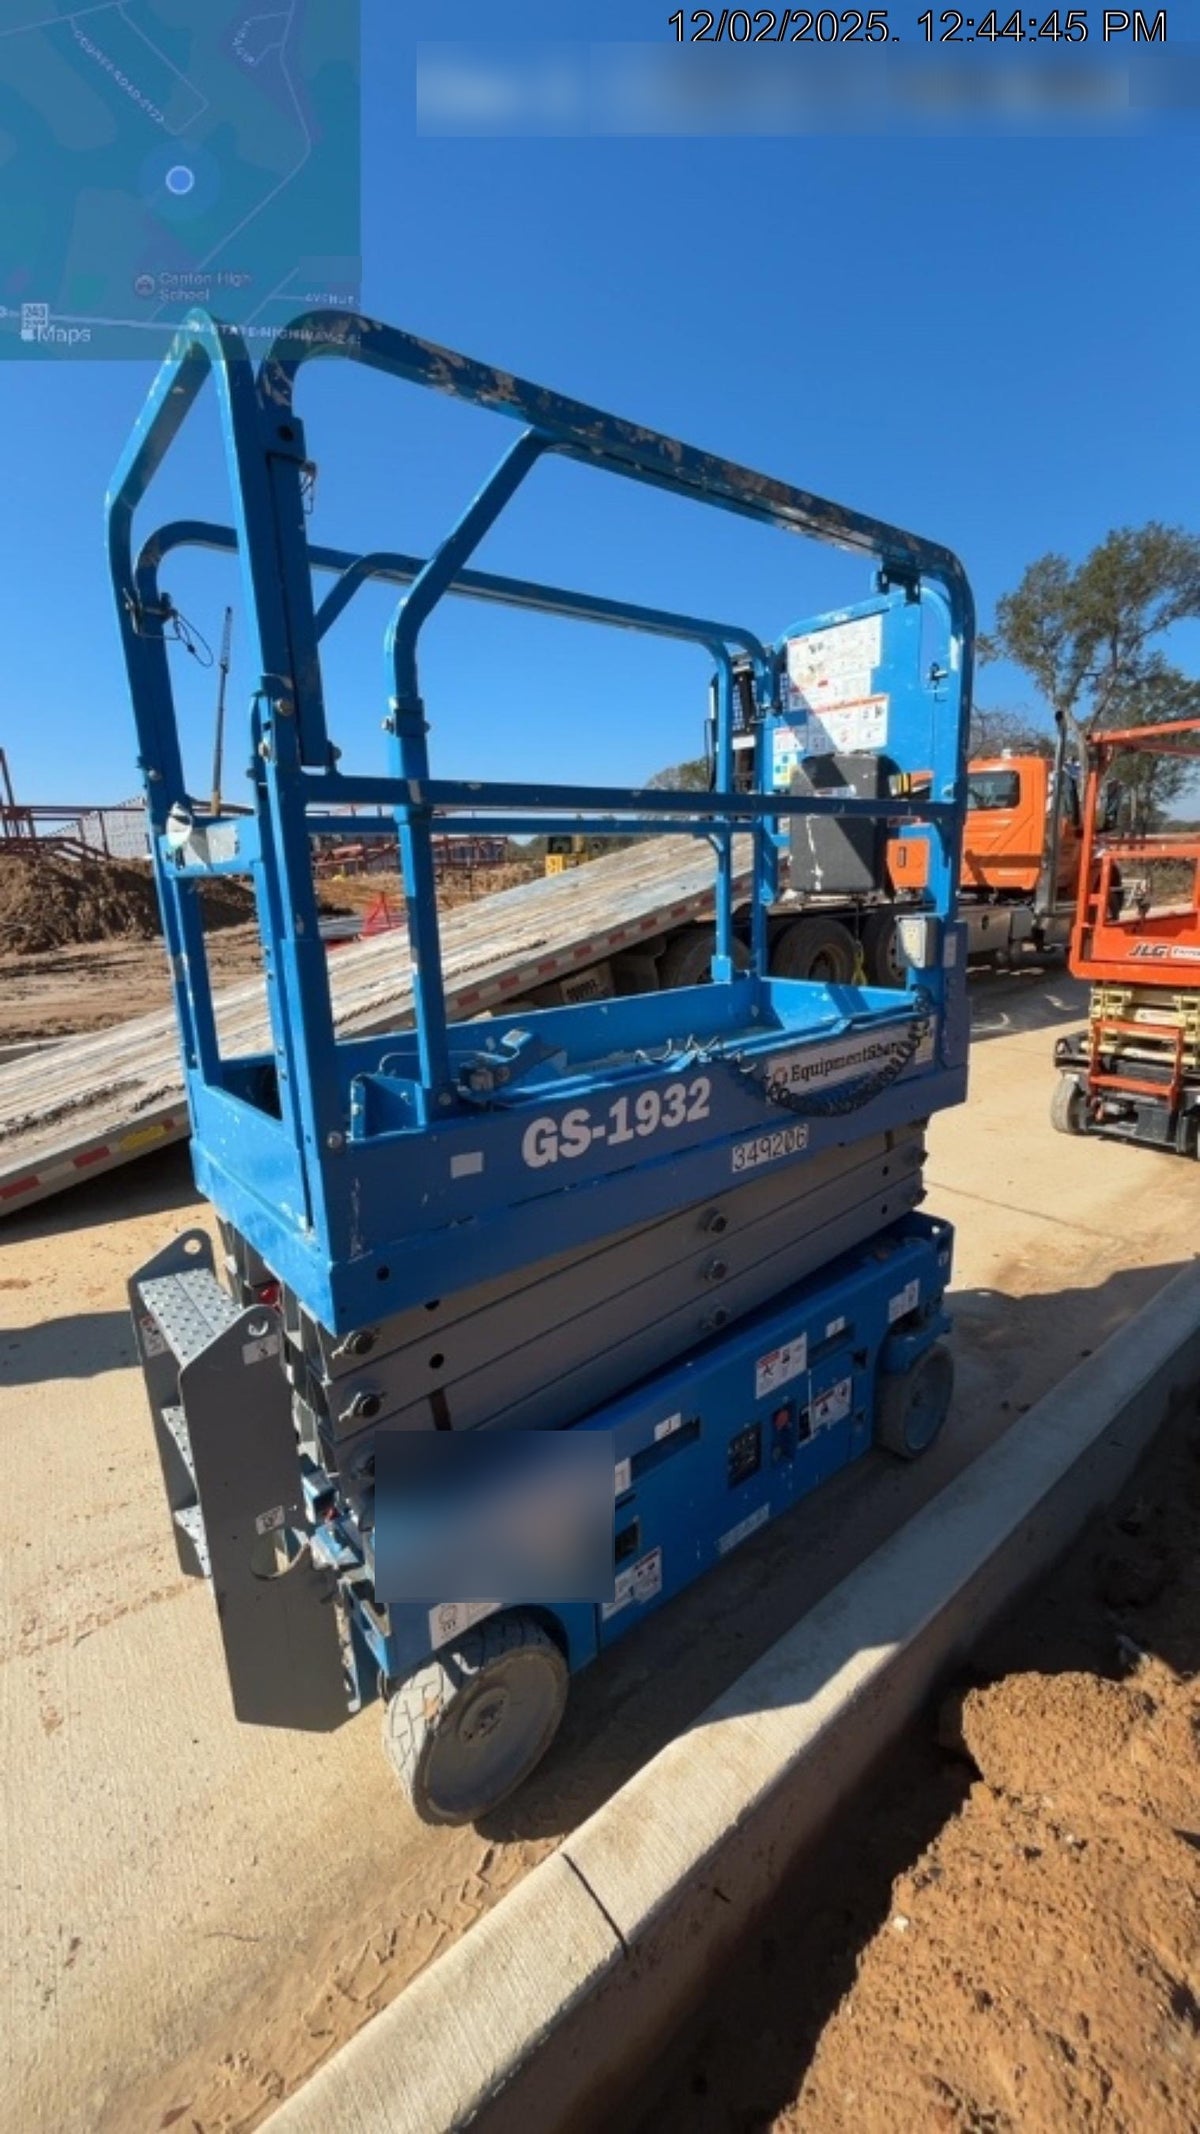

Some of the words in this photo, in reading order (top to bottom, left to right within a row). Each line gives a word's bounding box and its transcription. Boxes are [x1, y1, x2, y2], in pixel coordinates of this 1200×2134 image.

[1128, 943, 1168, 957] JLG
[790, 1040, 908, 1083] EquipmentShar
[521, 1076, 711, 1169] GS-1932
[734, 1126, 806, 1169] 349206
